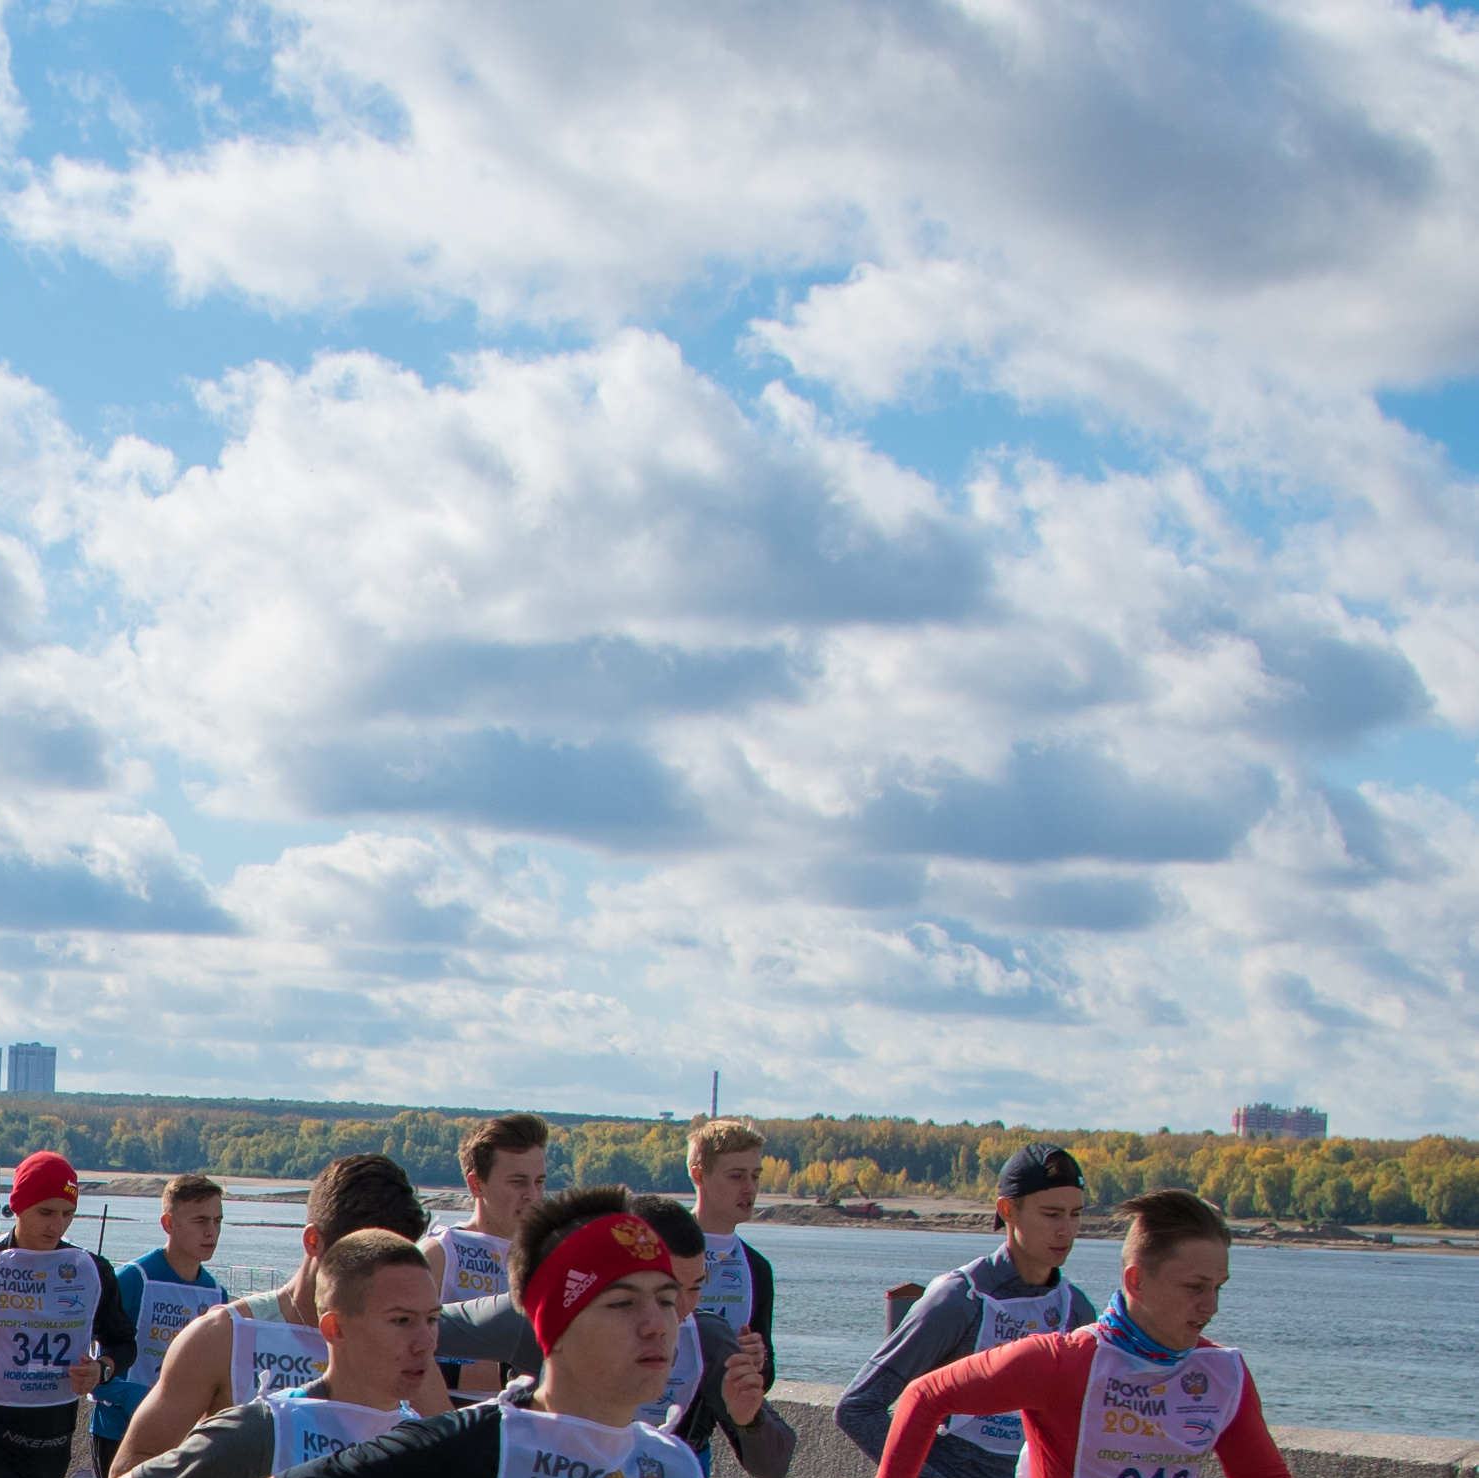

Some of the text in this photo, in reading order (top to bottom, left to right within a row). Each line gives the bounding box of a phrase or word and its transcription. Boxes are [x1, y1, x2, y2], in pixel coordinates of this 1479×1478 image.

[457, 1270, 499, 1293] 2021
[563, 1273, 598, 1308] adidas
[153, 1301, 183, 1315] КРОСС
[12, 1333, 71, 1366] 342
[253, 1352, 312, 1374] КРОСС
[20, 1382, 58, 1392] ОБЛАСТЬ
[2, 1430, 68, 1448] NIKE PRO
[980, 1425, 1021, 1441] ОБЛАСТЬ
[1097, 1449, 1132, 1460] СПОРТ
